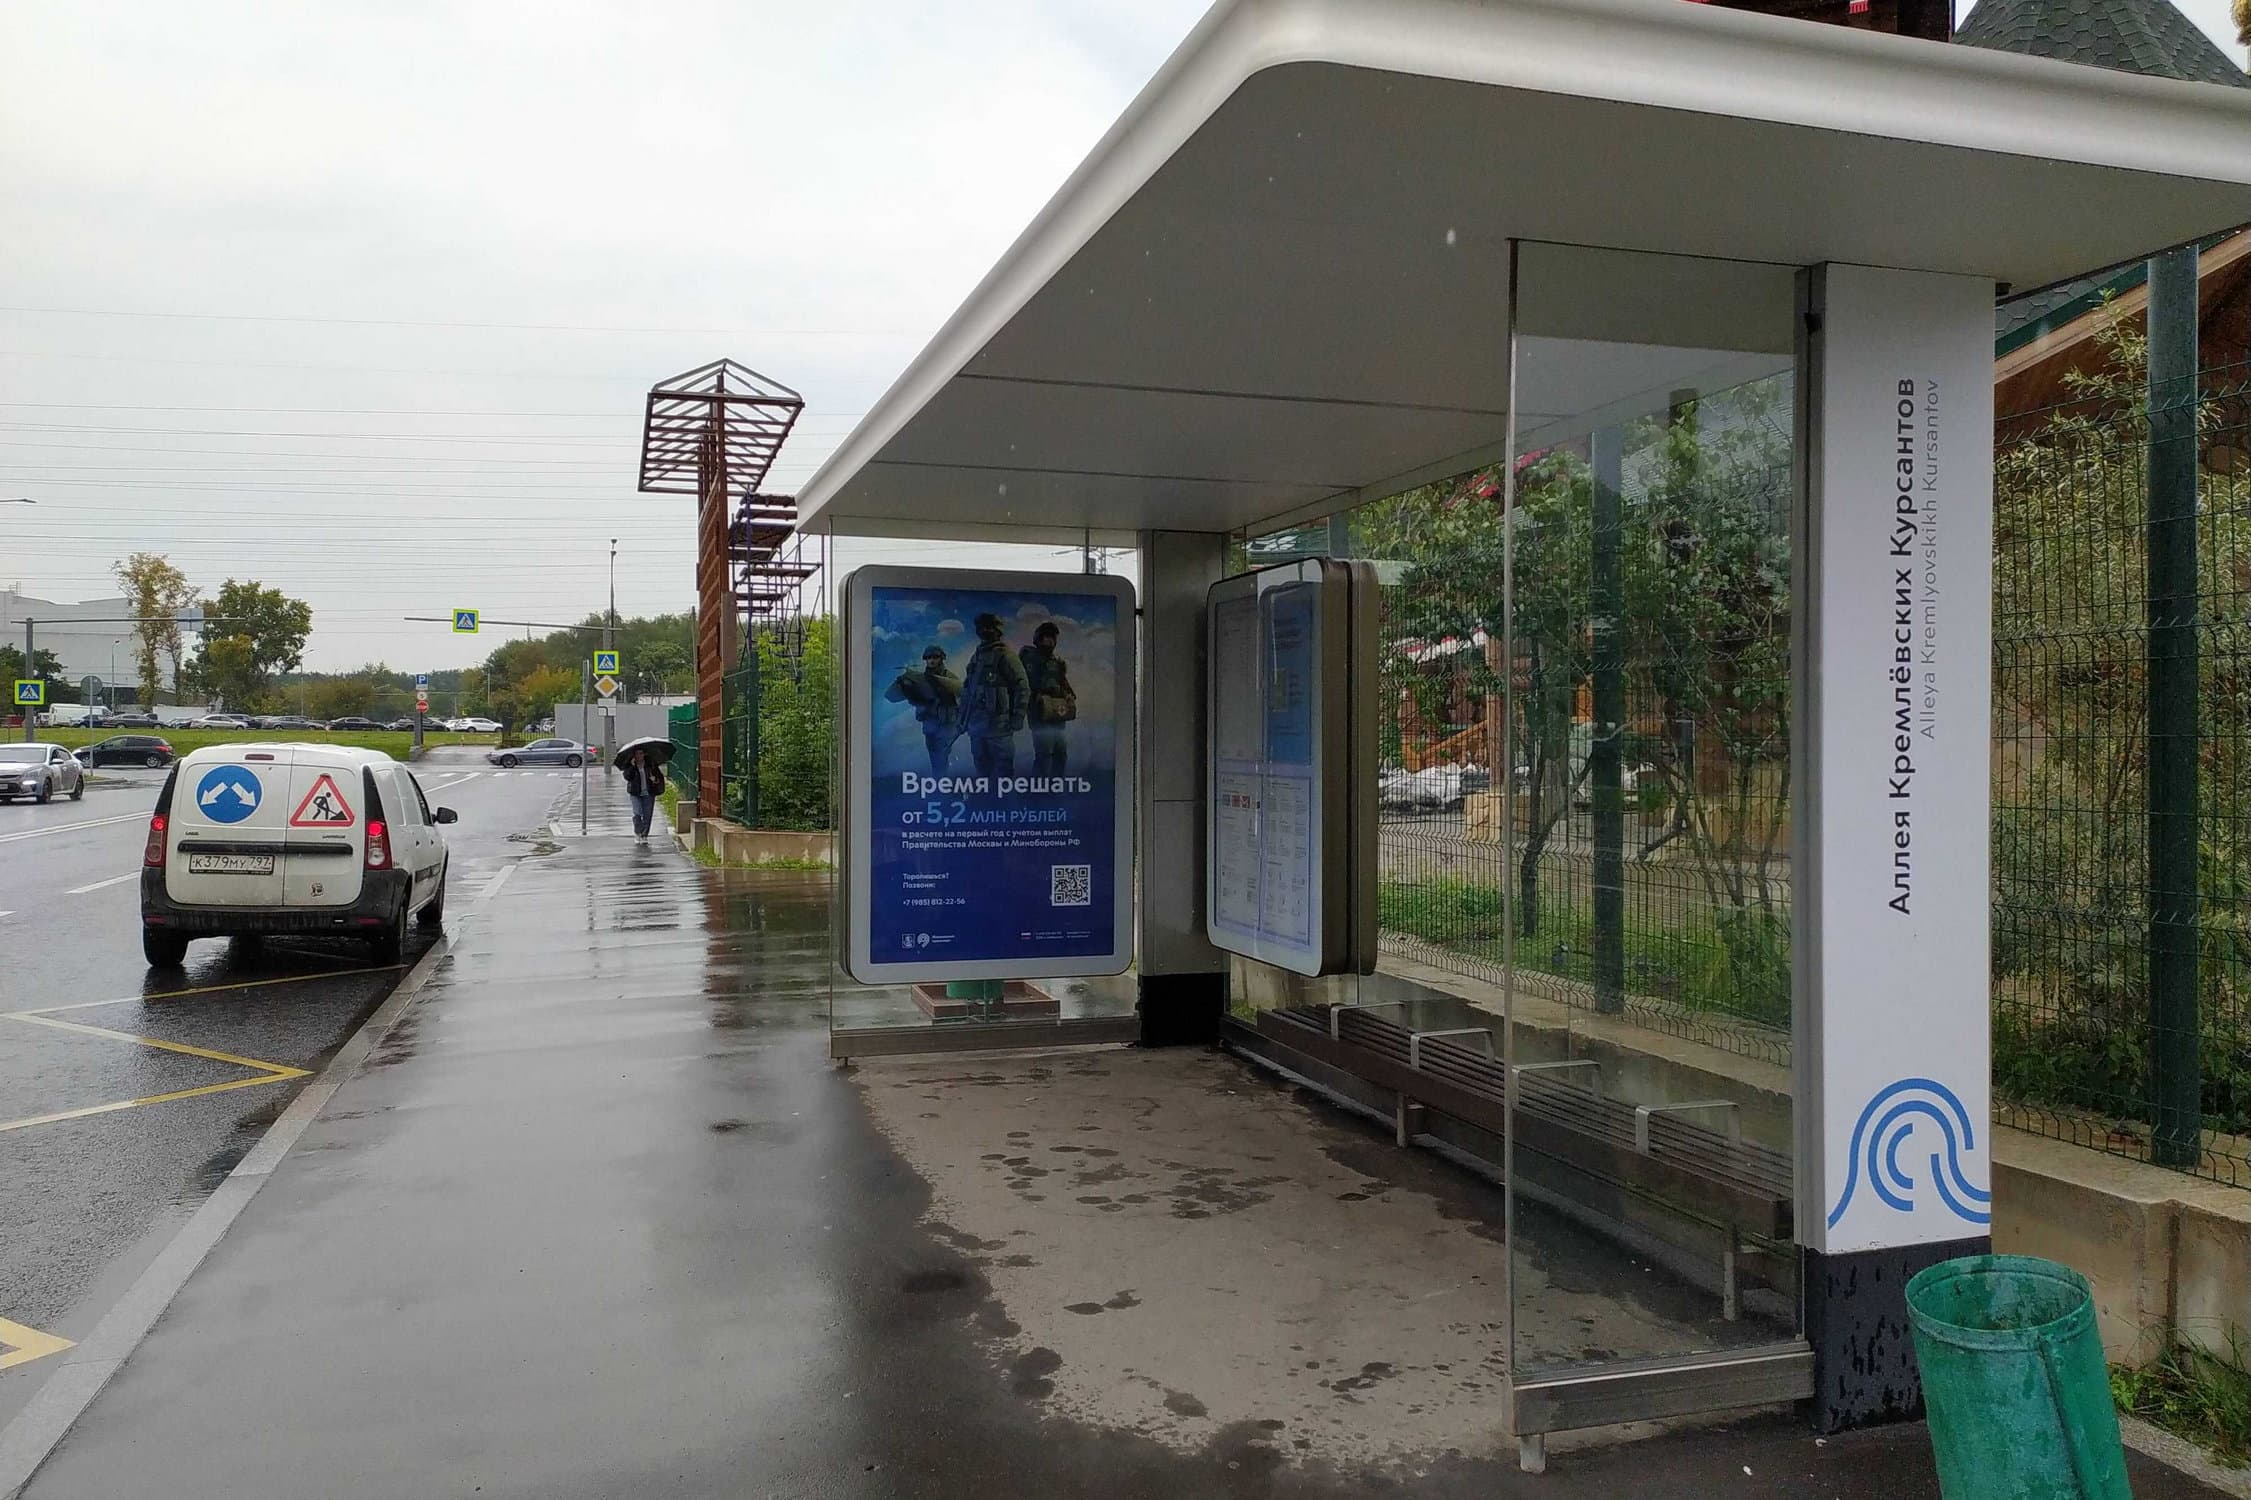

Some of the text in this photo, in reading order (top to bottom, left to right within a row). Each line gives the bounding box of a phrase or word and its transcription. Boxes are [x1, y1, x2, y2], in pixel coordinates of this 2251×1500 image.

[1920, 379, 1940, 740] Alleya Kremlyovskikh Kursantov
[1888, 378, 1918, 915] Аллея Кремлёвских Курсантов
[902, 771, 1092, 799] Время решать
[927, 801, 966, 827] 5,2
[970, 811, 1006, 823] МЛН
[1010, 808, 1067, 823] РУБЛЕЙ
[902, 840, 966, 850] Правительства
[967, 839, 1002, 848] Москвы
[1010, 839, 1066, 848] Минобороны
[1068, 838, 1081, 847] РФ
[909, 831, 943, 839] расчете
[956, 829, 989, 839] первый
[990, 830, 1004, 838] год
[1011, 830, 1042, 838] учетом
[1043, 829, 1073, 837] выплат
[249, 856, 270, 867] 797
